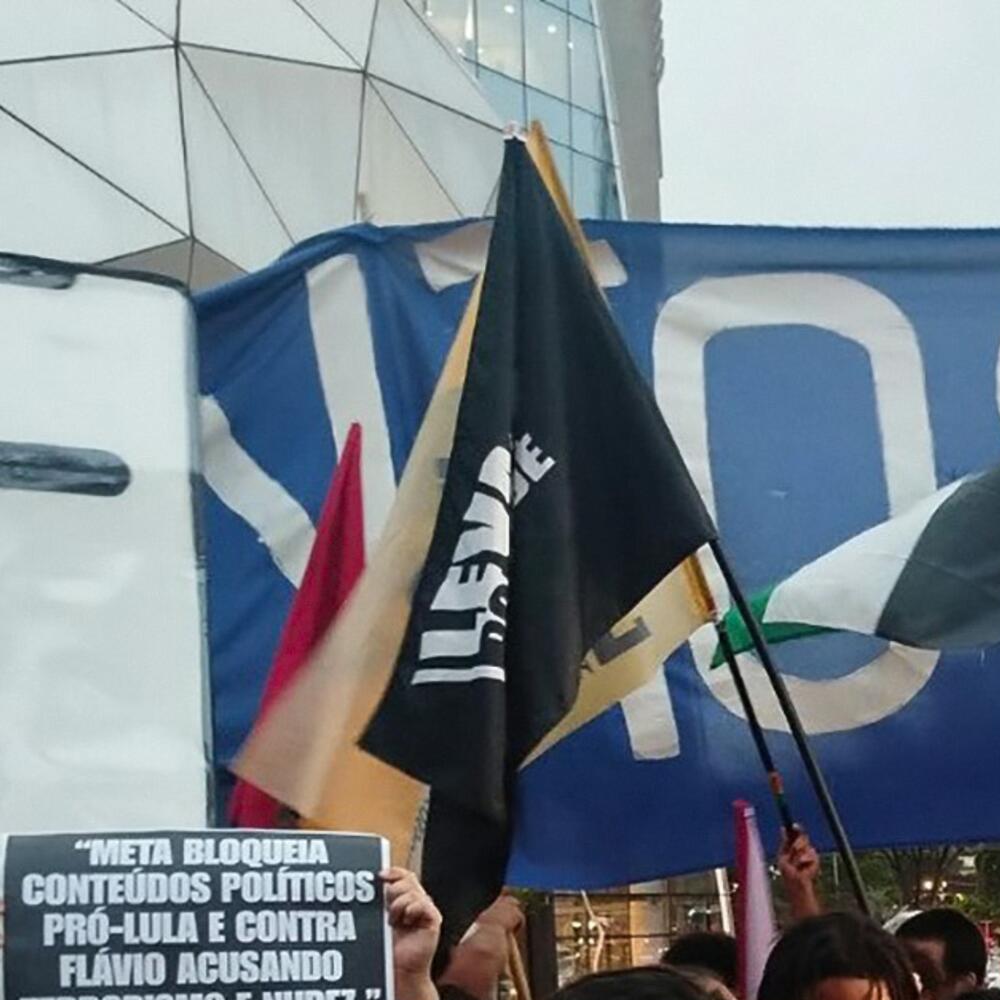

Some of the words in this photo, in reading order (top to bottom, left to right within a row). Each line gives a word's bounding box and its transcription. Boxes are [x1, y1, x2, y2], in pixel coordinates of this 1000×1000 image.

[75, 838, 173, 867] “META
[183, 838, 328, 868] BLOQUEIA
[22, 868, 211, 906] CONTEÚDOS
[220, 866, 375, 903] POLÍTICOS
[43, 906, 198, 947] PRÓ-LULA
[209, 911, 225, 943] E
[235, 910, 356, 943] CONTRA
[59, 948, 166, 987] FLÁVIO
[177, 950, 343, 984] ACUSANDO
